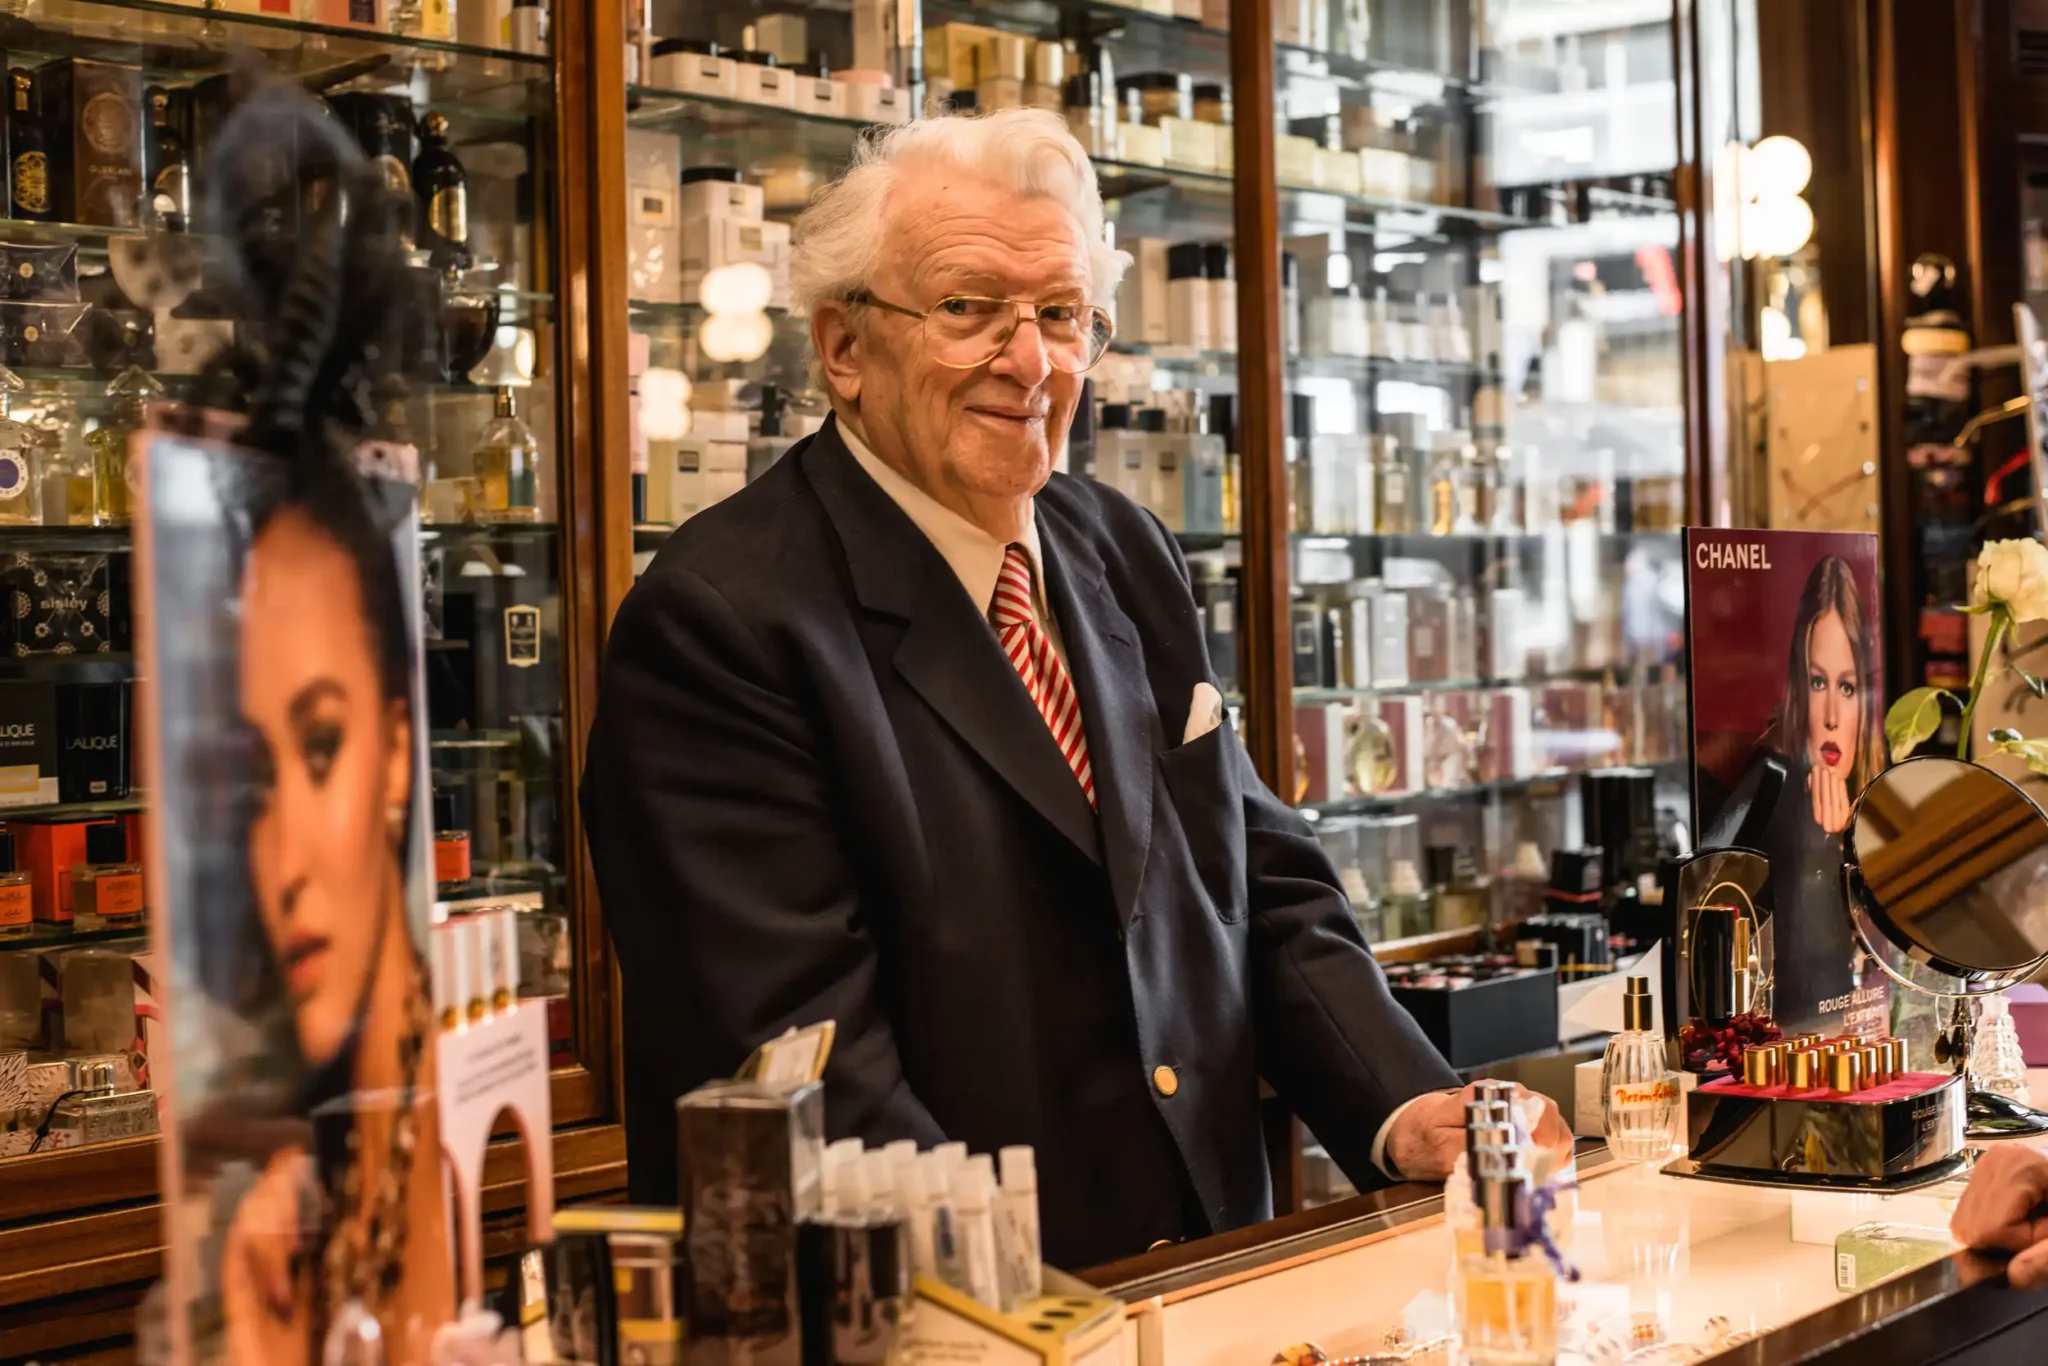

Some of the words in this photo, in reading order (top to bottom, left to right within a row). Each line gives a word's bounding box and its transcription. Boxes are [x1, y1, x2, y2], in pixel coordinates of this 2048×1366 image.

[1696, 542, 1772, 570] CHANEL
[40, 597, 88, 612] sisley
[0, 723, 35, 738] LIQUE
[65, 735, 118, 751] LALIQUE
[1818, 994, 1850, 1014] ROUGE
[1851, 985, 1885, 1005] ALLURE
